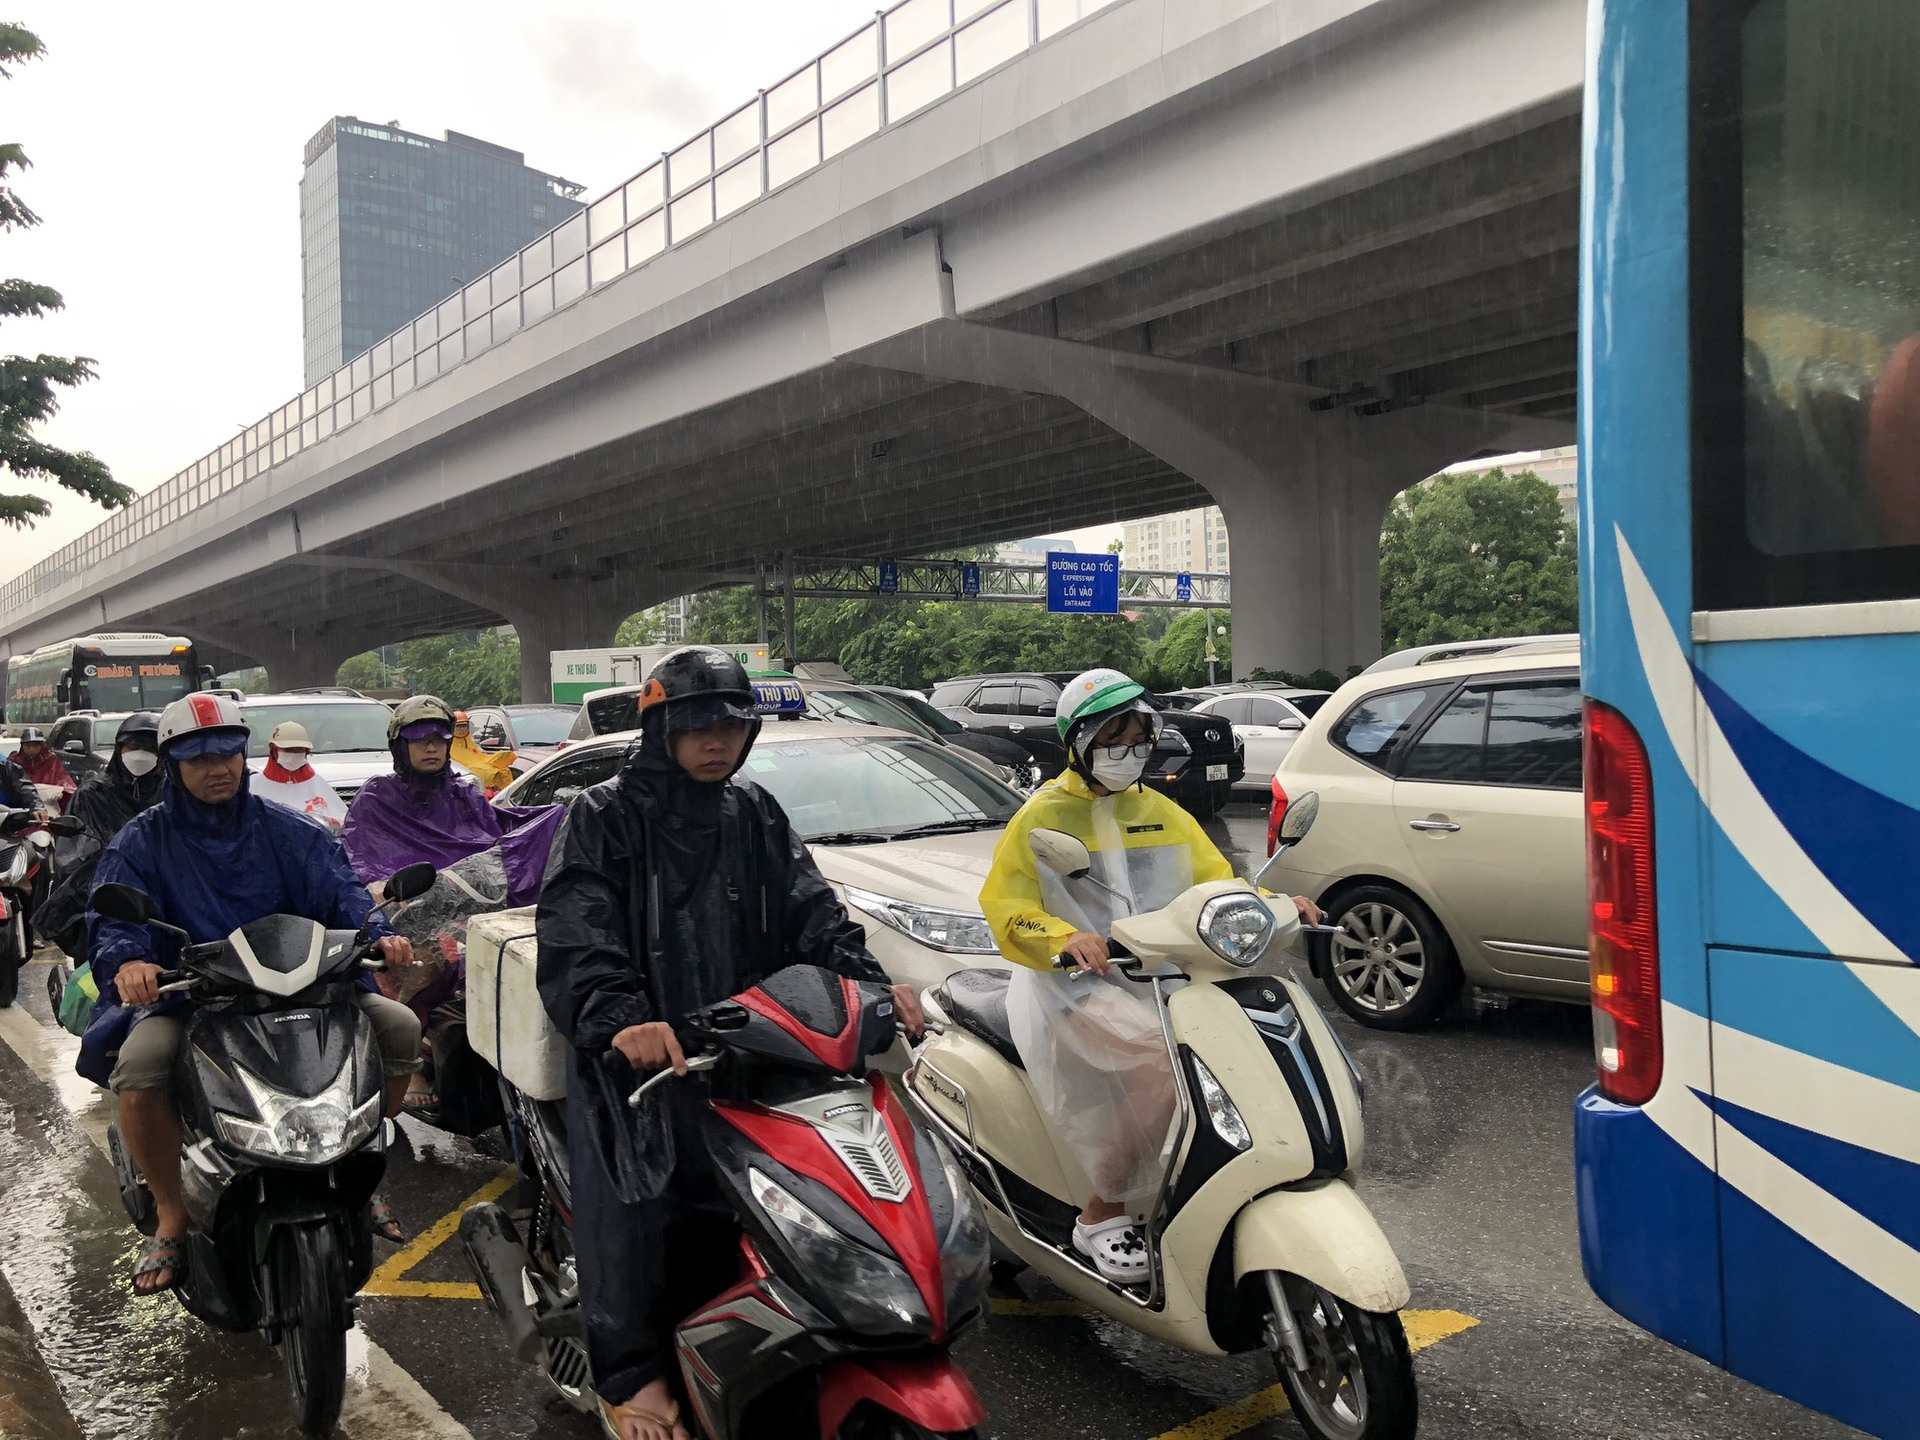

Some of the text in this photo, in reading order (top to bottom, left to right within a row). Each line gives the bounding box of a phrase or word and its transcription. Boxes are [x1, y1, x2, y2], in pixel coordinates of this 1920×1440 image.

[1052, 558, 1114, 572] ĐƯỜNG CAO TỐC
[1064, 584, 1093, 597] LỐI VÀO
[1065, 600, 1092, 608] ENTRANCE
[567, 664, 574, 675] XE
[274, 1014, 311, 1022] HONDA
[824, 1104, 865, 1117] HONDA
